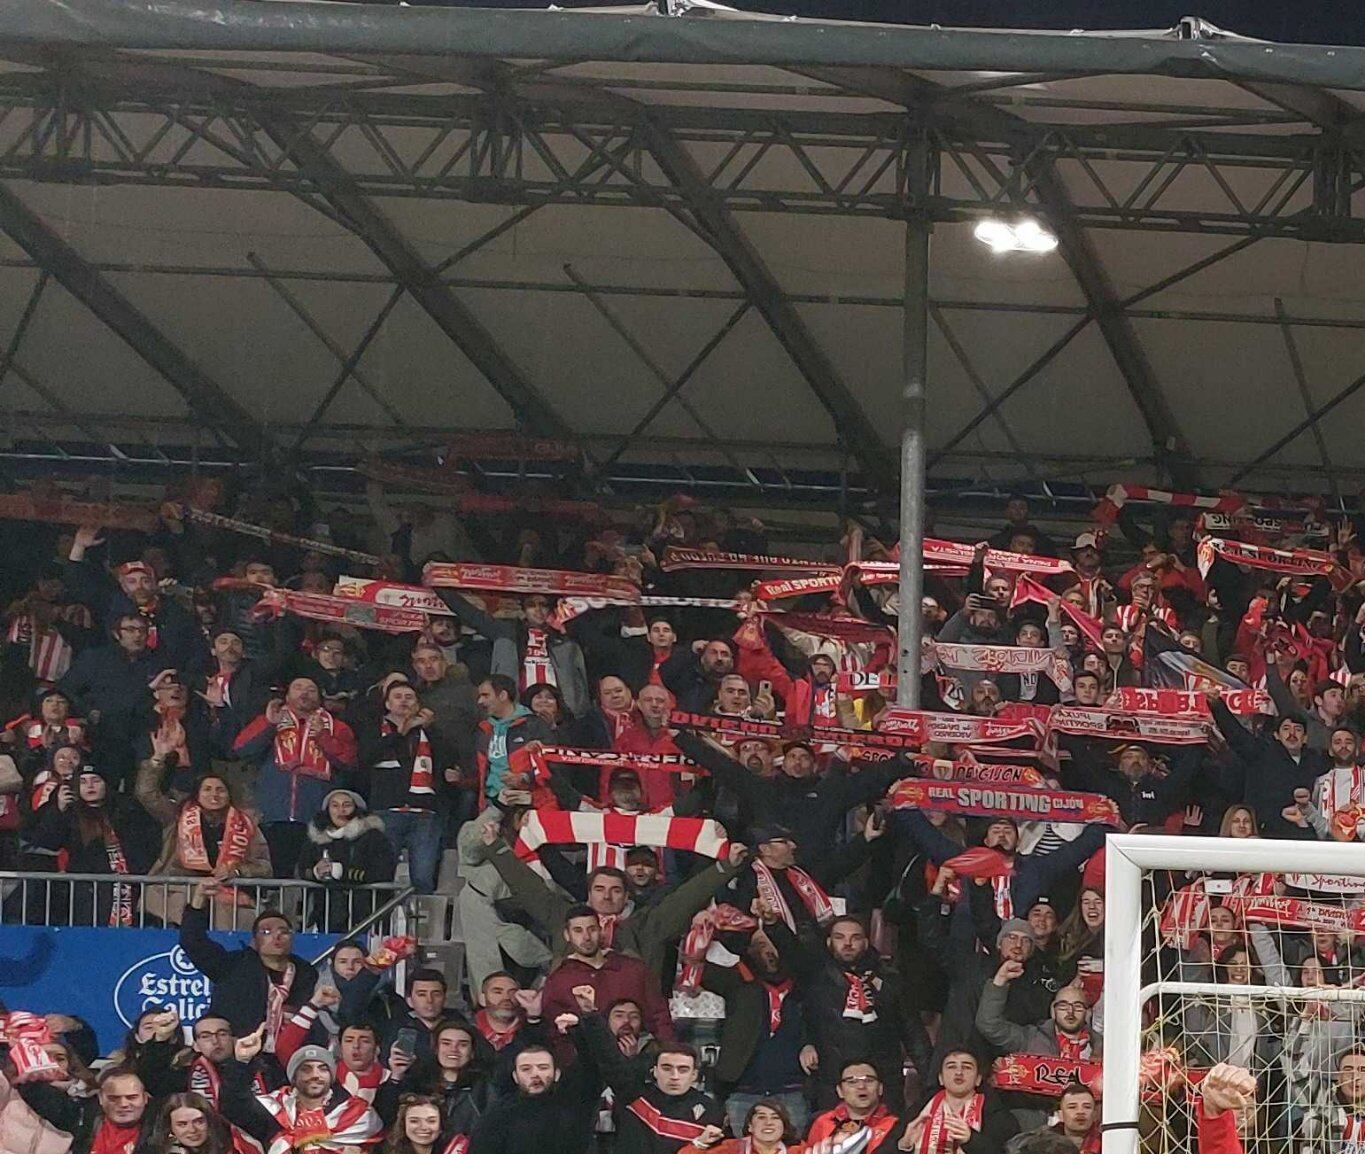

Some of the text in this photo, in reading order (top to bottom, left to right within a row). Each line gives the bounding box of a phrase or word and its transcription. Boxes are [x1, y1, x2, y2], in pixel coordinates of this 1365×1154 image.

[927, 787, 956, 800] REAL
[956, 789, 1052, 814] SPORTING
[137, 972, 212, 996] Estrel
